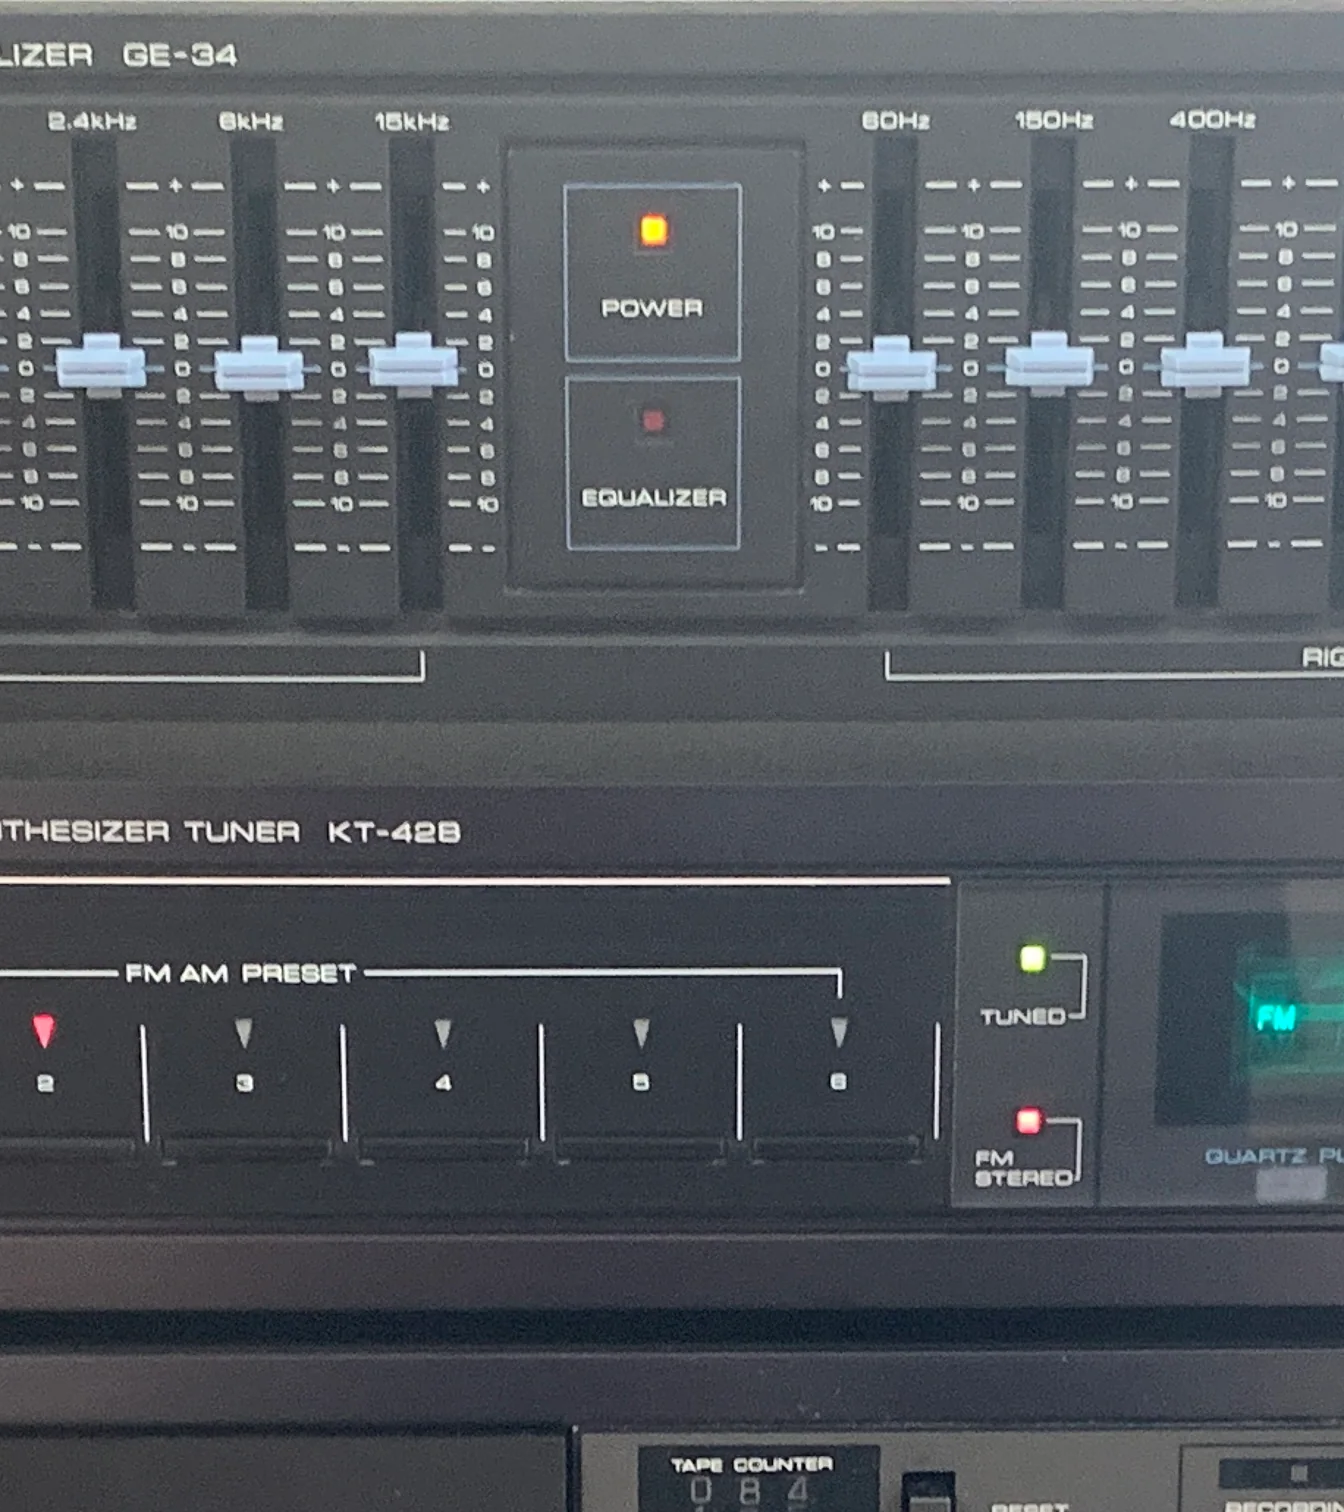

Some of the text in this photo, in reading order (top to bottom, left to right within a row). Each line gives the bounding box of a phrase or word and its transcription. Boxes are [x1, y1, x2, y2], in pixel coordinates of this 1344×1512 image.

[124, 42, 237, 67] GE-34
[49, 112, 136, 130] 2.4kHz
[219, 112, 283, 130] 6kHz
[375, 112, 449, 130] 15kHz
[863, 111, 929, 130] 60Hz
[1016, 110, 1093, 129] 150Hz
[1170, 110, 1256, 129] 400Hz
[600, 299, 702, 317] POWER
[583, 488, 726, 507] EQUALIZER
[184, 821, 299, 842] TUNER
[329, 821, 460, 843] KT-42B
[126, 963, 356, 983] FM AM PRESET
[981, 1008, 1065, 1025] TUNED
[1257, 1004, 1296, 1030] FM
[38, 1075, 53, 1092] 2
[237, 1074, 253, 1092] 3
[436, 1075, 451, 1090] 4
[976, 1150, 1013, 1166] FM
[1206, 1144, 1306, 1164] QUARTZ
[976, 1170, 1073, 1187] STEREO
[672, 1457, 832, 1472] TAPE COUNTER
